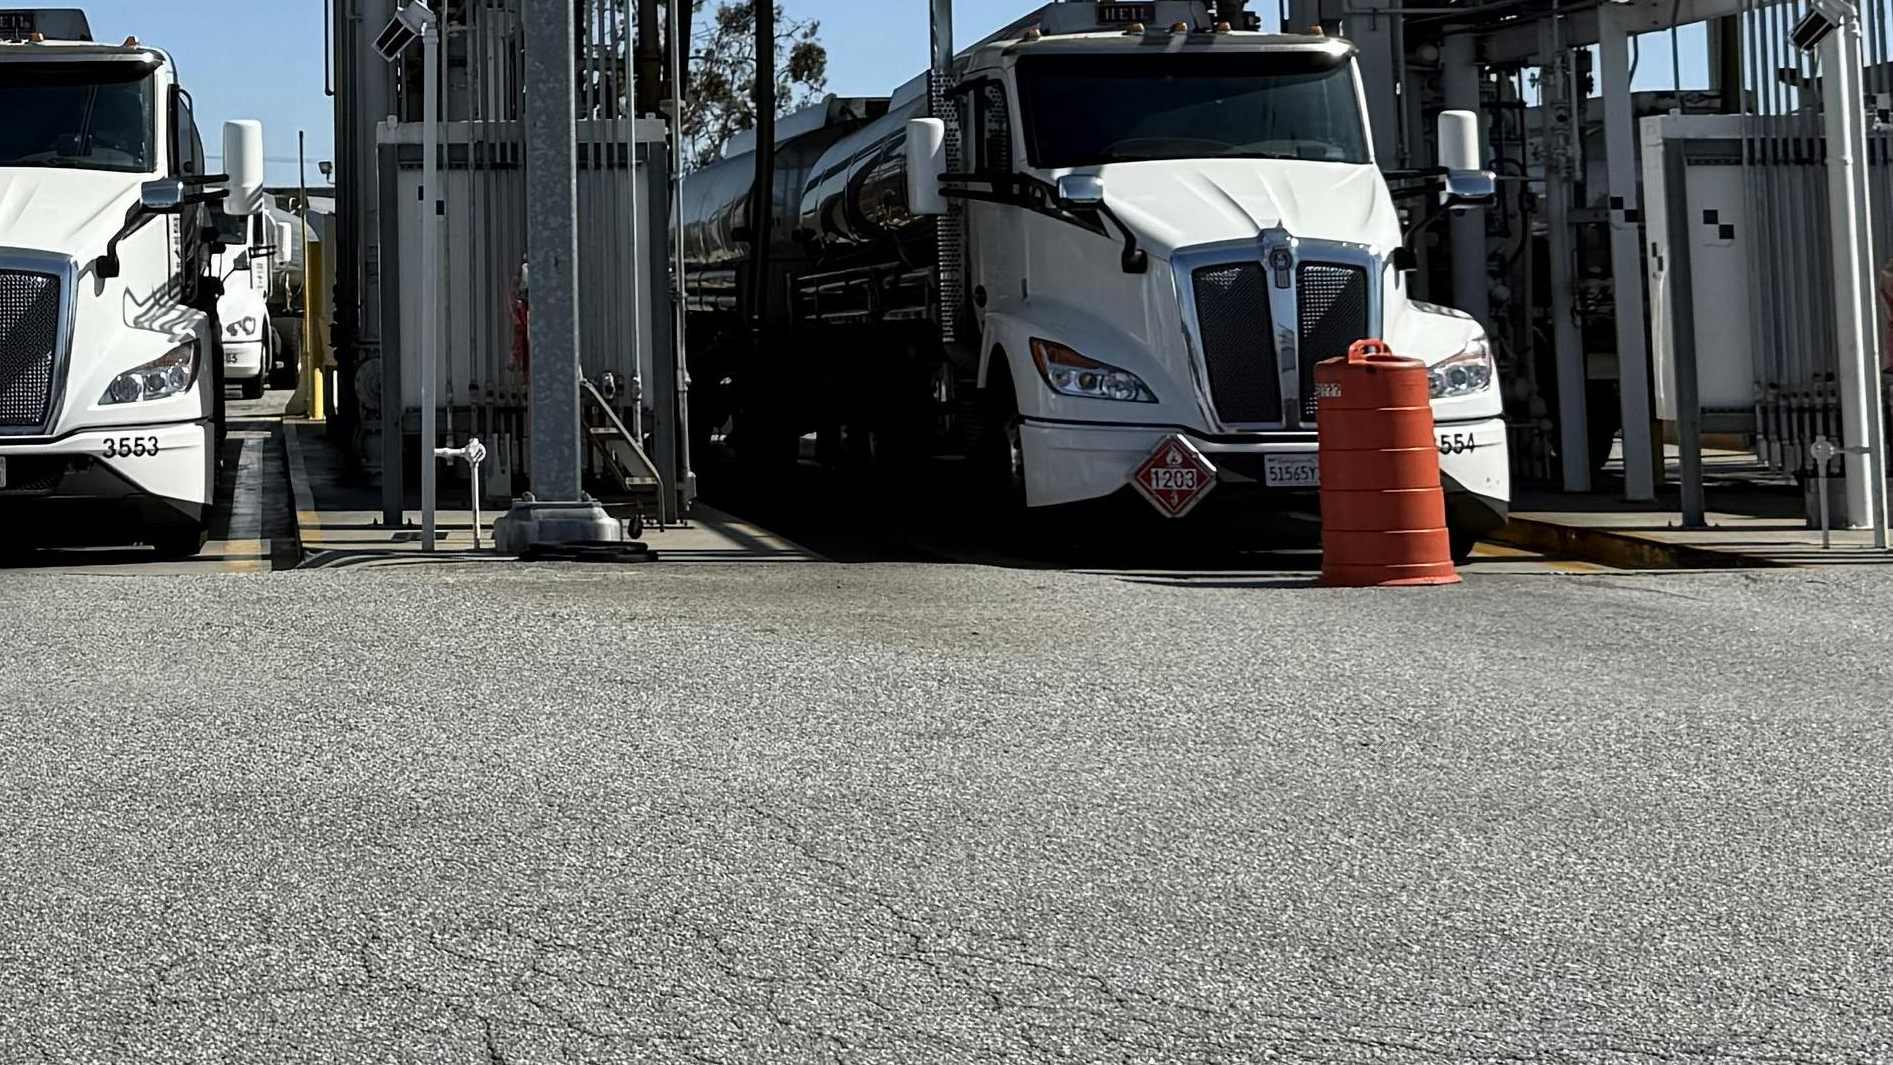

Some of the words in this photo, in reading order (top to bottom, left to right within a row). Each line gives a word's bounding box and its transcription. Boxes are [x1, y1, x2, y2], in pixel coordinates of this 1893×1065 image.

[103, 436, 159, 459] 3553
[1436, 432, 1475, 455] 554
[1154, 470, 1197, 489] 1203
[1269, 465, 1318, 482] 51565Y
[1169, 491, 1179, 506] 3
